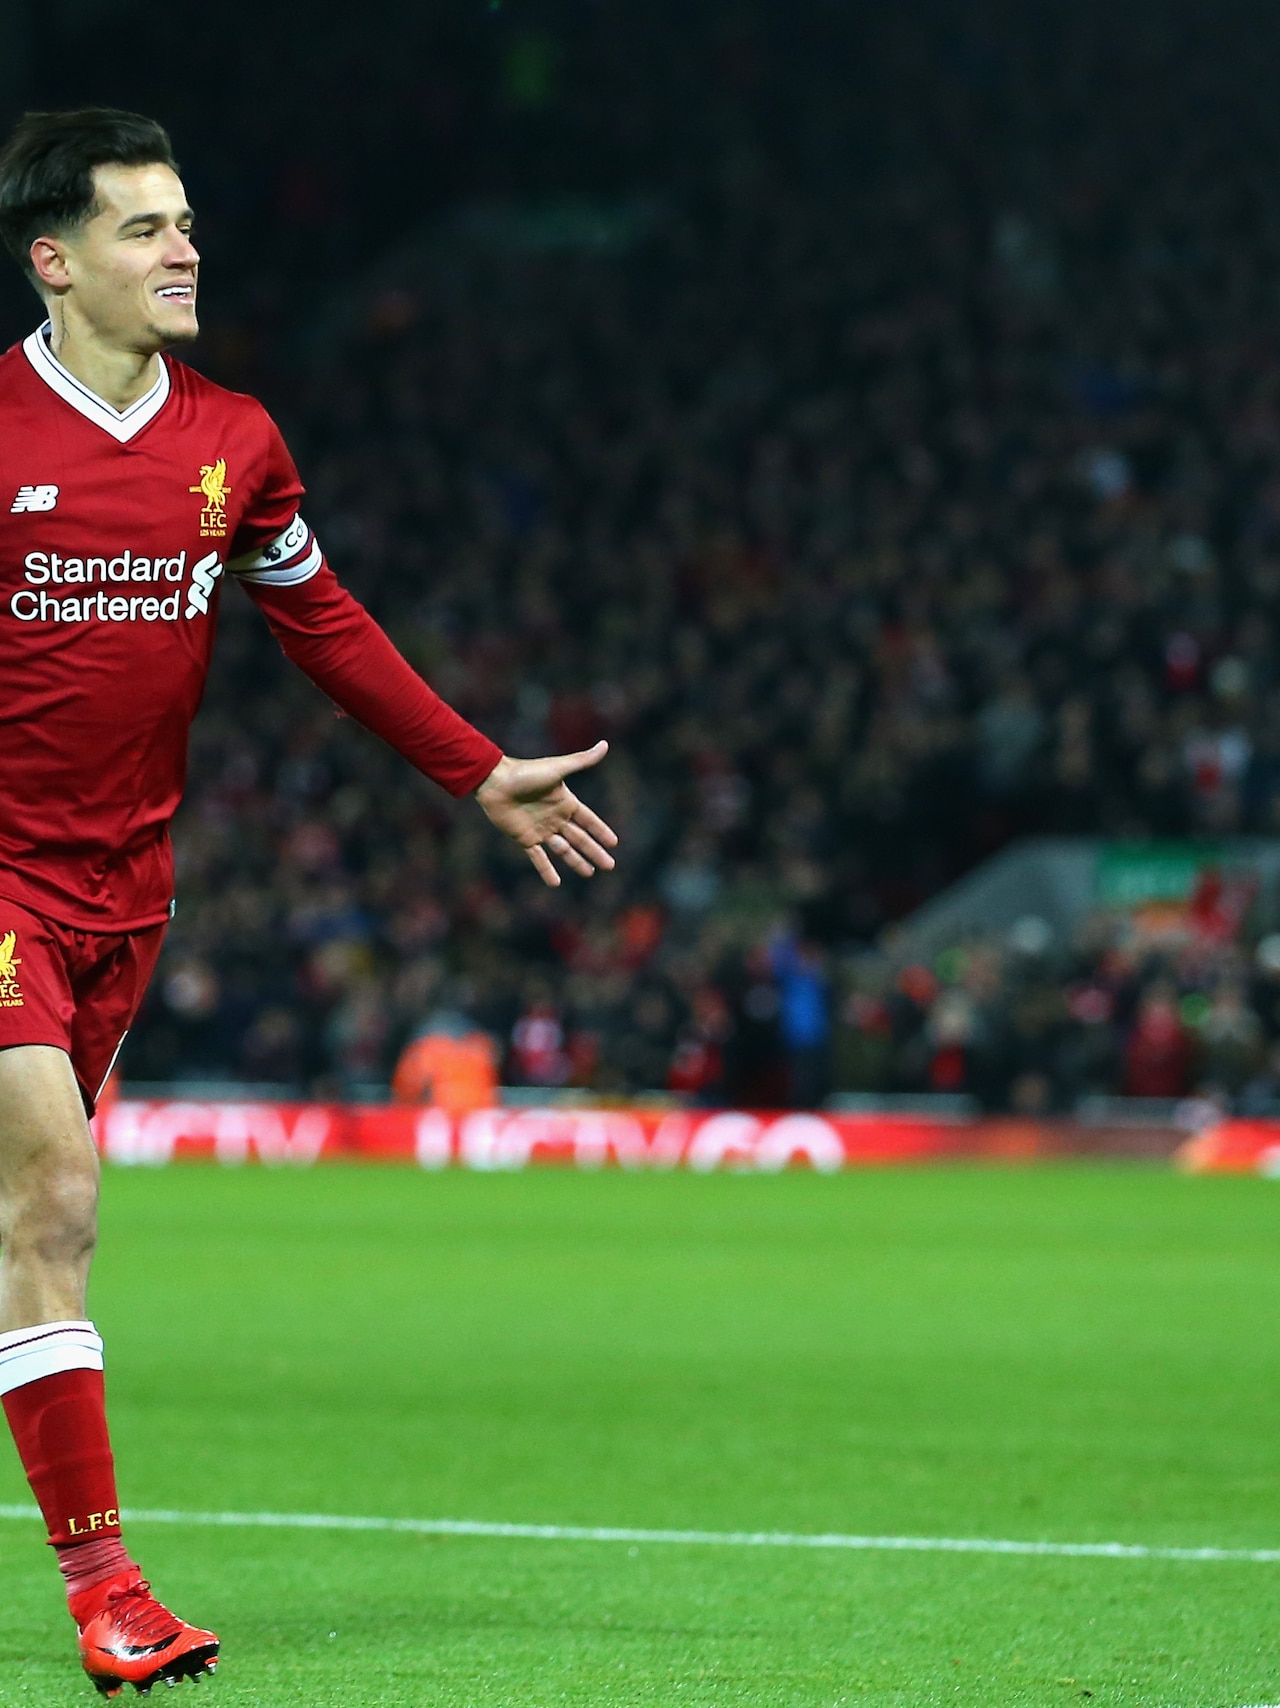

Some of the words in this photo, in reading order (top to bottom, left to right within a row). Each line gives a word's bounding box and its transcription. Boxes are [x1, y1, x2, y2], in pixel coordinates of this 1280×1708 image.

[24, 550, 186, 584] Standard
[10, 590, 181, 622] Chartered
[3, 999, 24, 1007] YEARS
